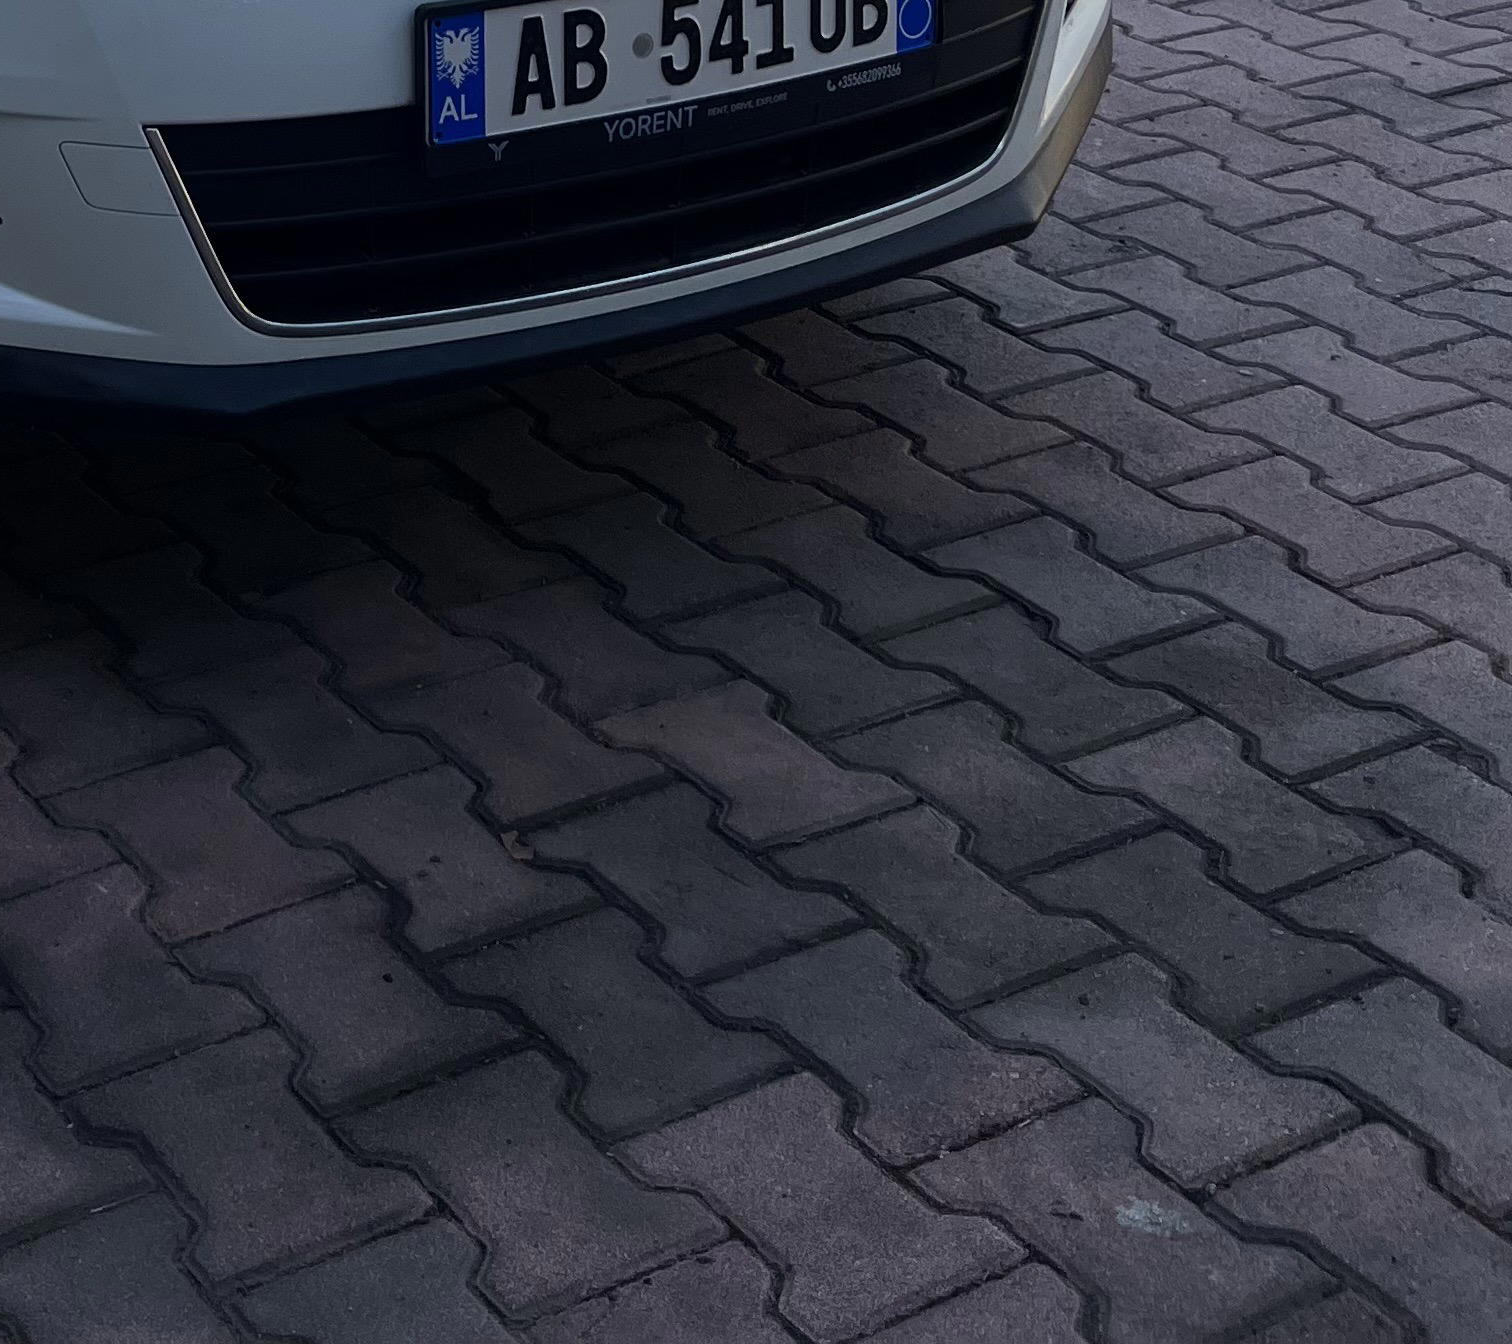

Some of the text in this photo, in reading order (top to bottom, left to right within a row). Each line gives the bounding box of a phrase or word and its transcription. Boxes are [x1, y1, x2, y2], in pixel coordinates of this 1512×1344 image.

[512, 8, 608, 116] AB
[439, 96, 478, 124] AL
[604, 105, 699, 143] YORENT
